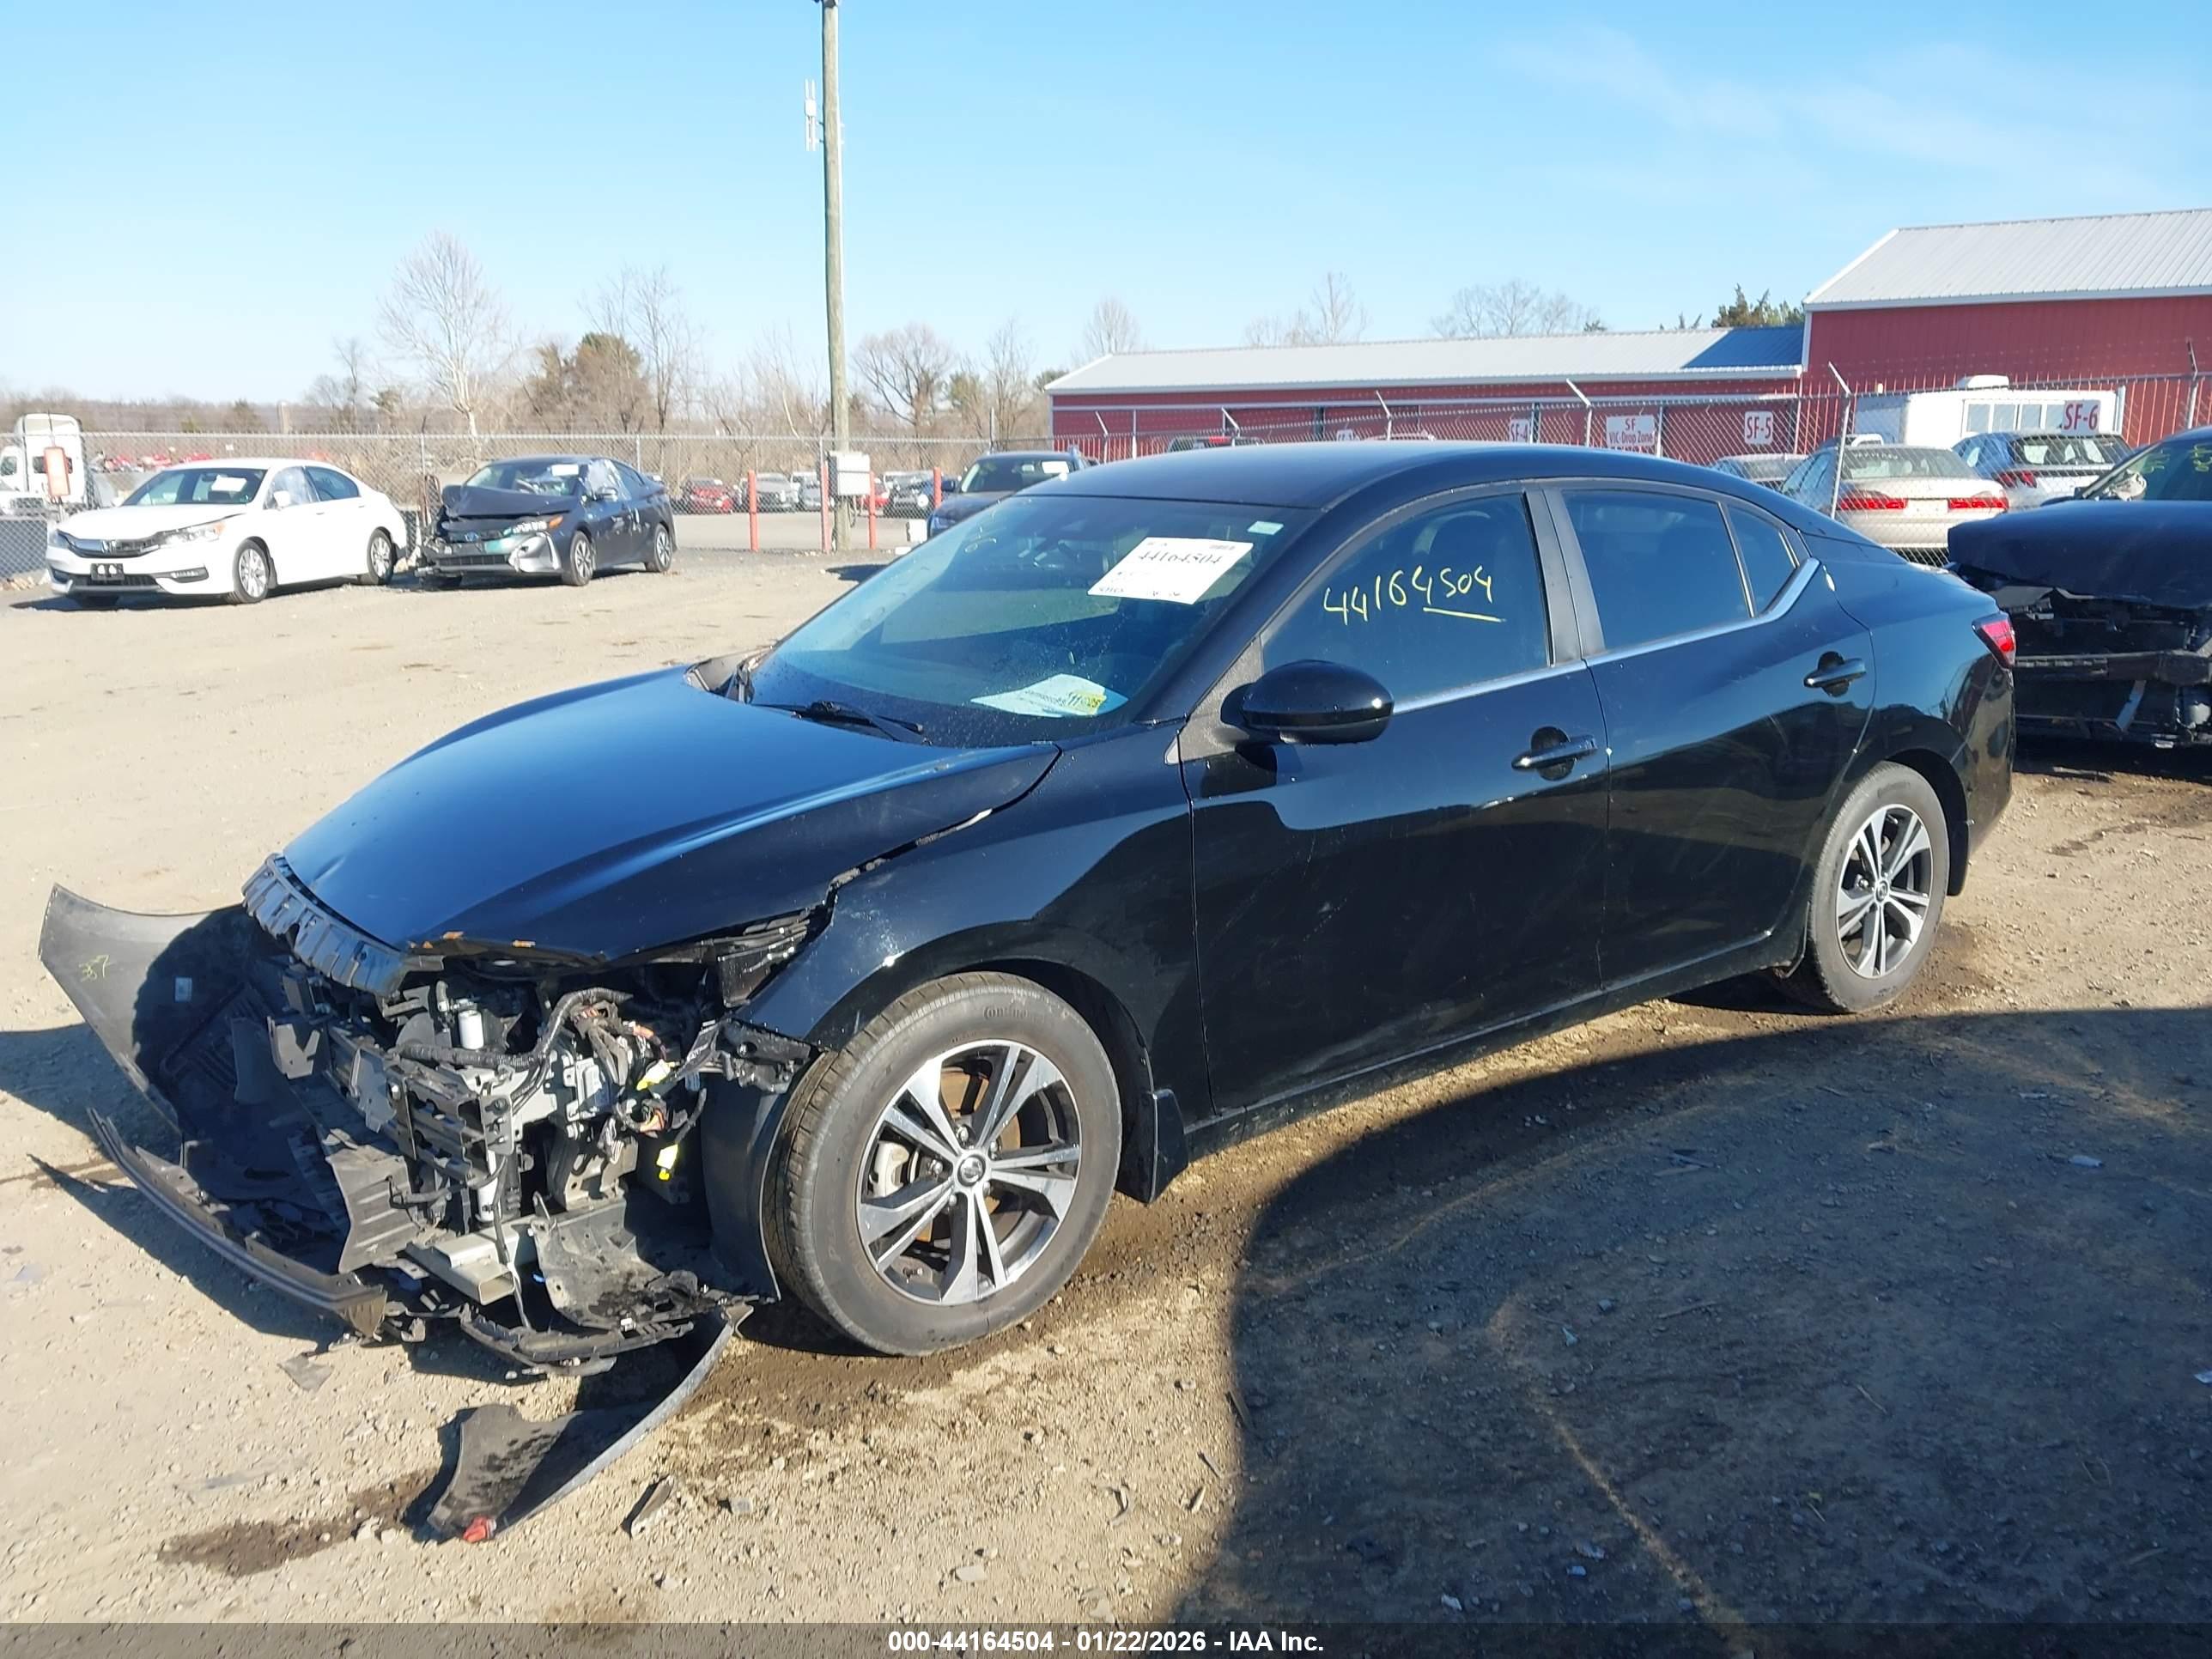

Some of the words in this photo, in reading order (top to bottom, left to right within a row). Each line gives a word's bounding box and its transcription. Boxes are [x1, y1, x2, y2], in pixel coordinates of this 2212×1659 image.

[1625, 417, 1636, 431] SF
[1746, 416, 1771, 439] SF-5
[2063, 403, 2099, 430] SF-6
[1637, 430, 1654, 444] Zone
[1322, 564, 1493, 626] 44164504
